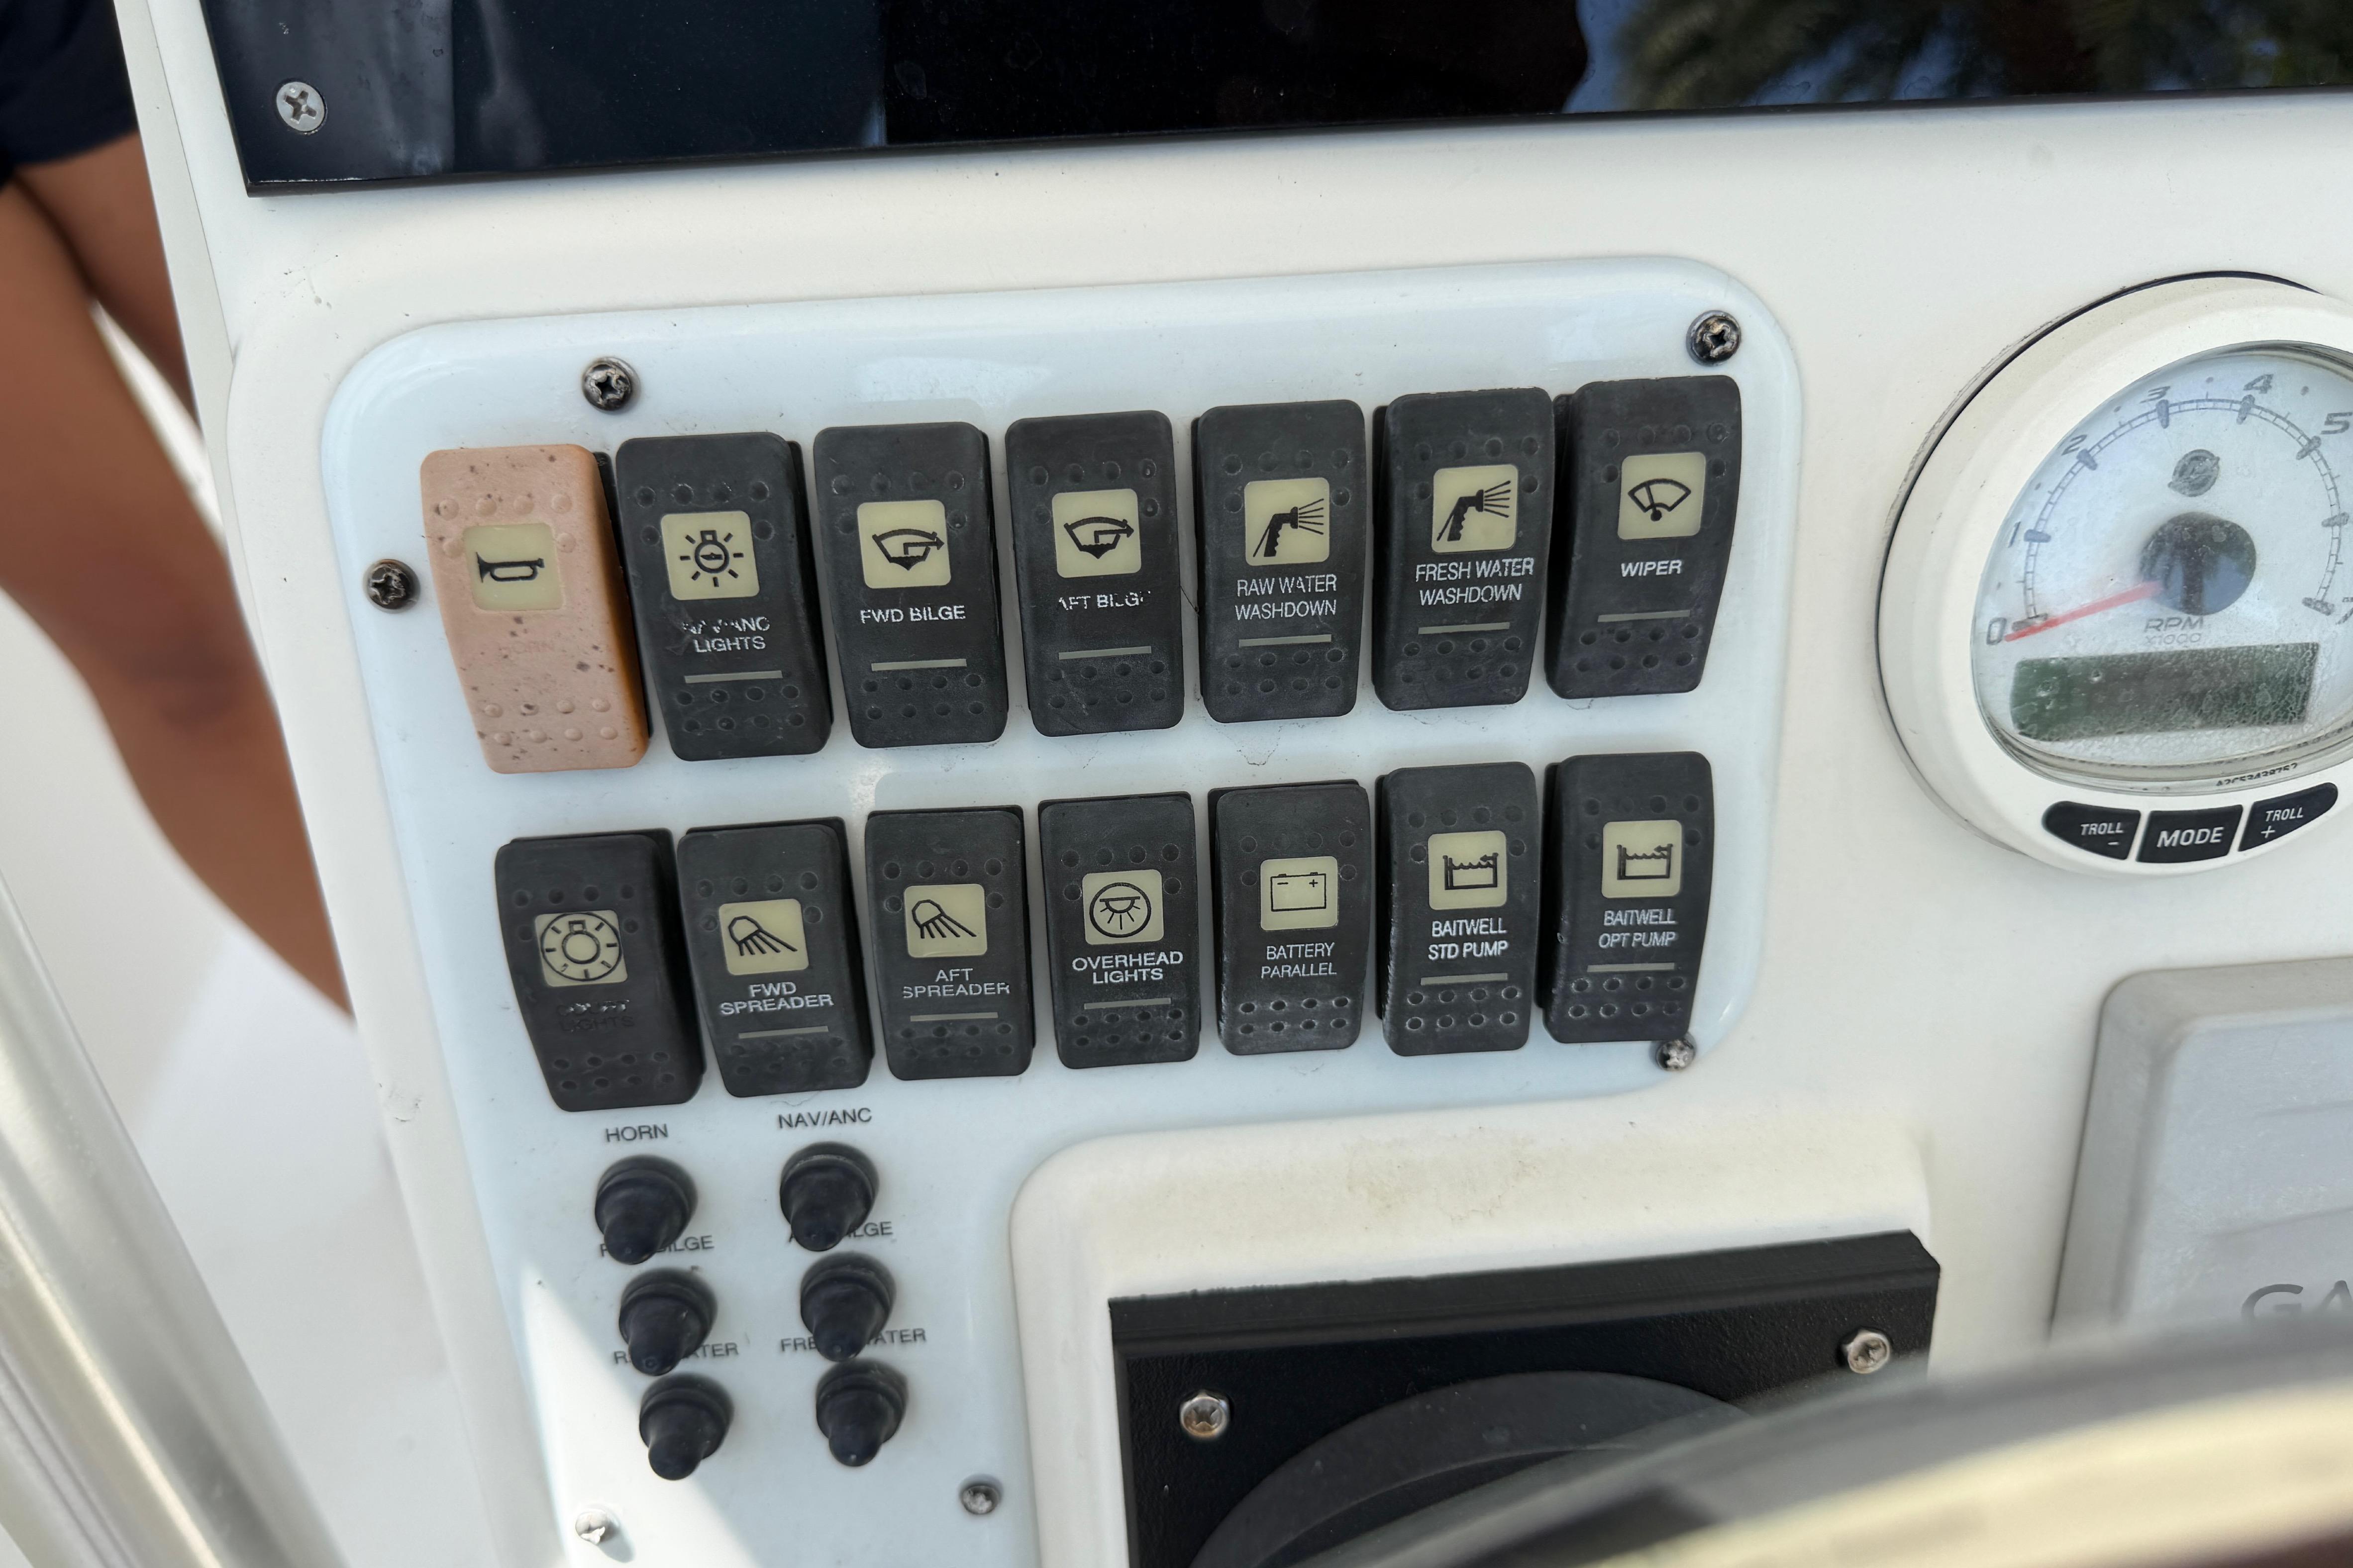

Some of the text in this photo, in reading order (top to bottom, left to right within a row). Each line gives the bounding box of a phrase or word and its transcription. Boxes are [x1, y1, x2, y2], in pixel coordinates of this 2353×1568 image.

[2243, 374, 2274, 394] 4
[2139, 386, 2171, 403] 3
[2320, 411, 2353, 435] 5
[2061, 434, 2087, 456] 2
[2008, 521, 2021, 548] 1
[1416, 557, 1534, 582] FRESH WATER
[1621, 559, 1683, 577] WIPER
[1237, 574, 1337, 597] RAW WATER
[1420, 583, 1522, 606] WASHDOWN
[860, 605, 966, 624] FWD BILGE
[1235, 599, 1336, 620] WASHDOWN
[1986, 617, 2007, 646] 0
[2144, 616, 2204, 633] RPM
[694, 636, 766, 653] LIGHTS
[2265, 807, 2304, 822] TROLL
[2080, 822, 2124, 836] TROLL
[2156, 826, 2225, 848] MODE
[1603, 908, 1677, 926] BAITWELL
[1432, 918, 1507, 937] BAITWELL
[1599, 931, 1677, 948] OPT PUMP
[1266, 942, 1335, 960] BATTERY
[1428, 940, 1508, 961] STD PUMP
[1072, 951, 1183, 971] OVERHEAD
[1261, 962, 1337, 979] PARALLEL
[935, 968, 973, 982] AFT
[1093, 968, 1163, 984] LIGHTS
[749, 981, 796, 997] FWD
[903, 982, 1010, 998] SPREADER
[720, 994, 834, 1015] SPREADER
[778, 1107, 872, 1129] NAV/ANC
[606, 1123, 668, 1142] HORN
